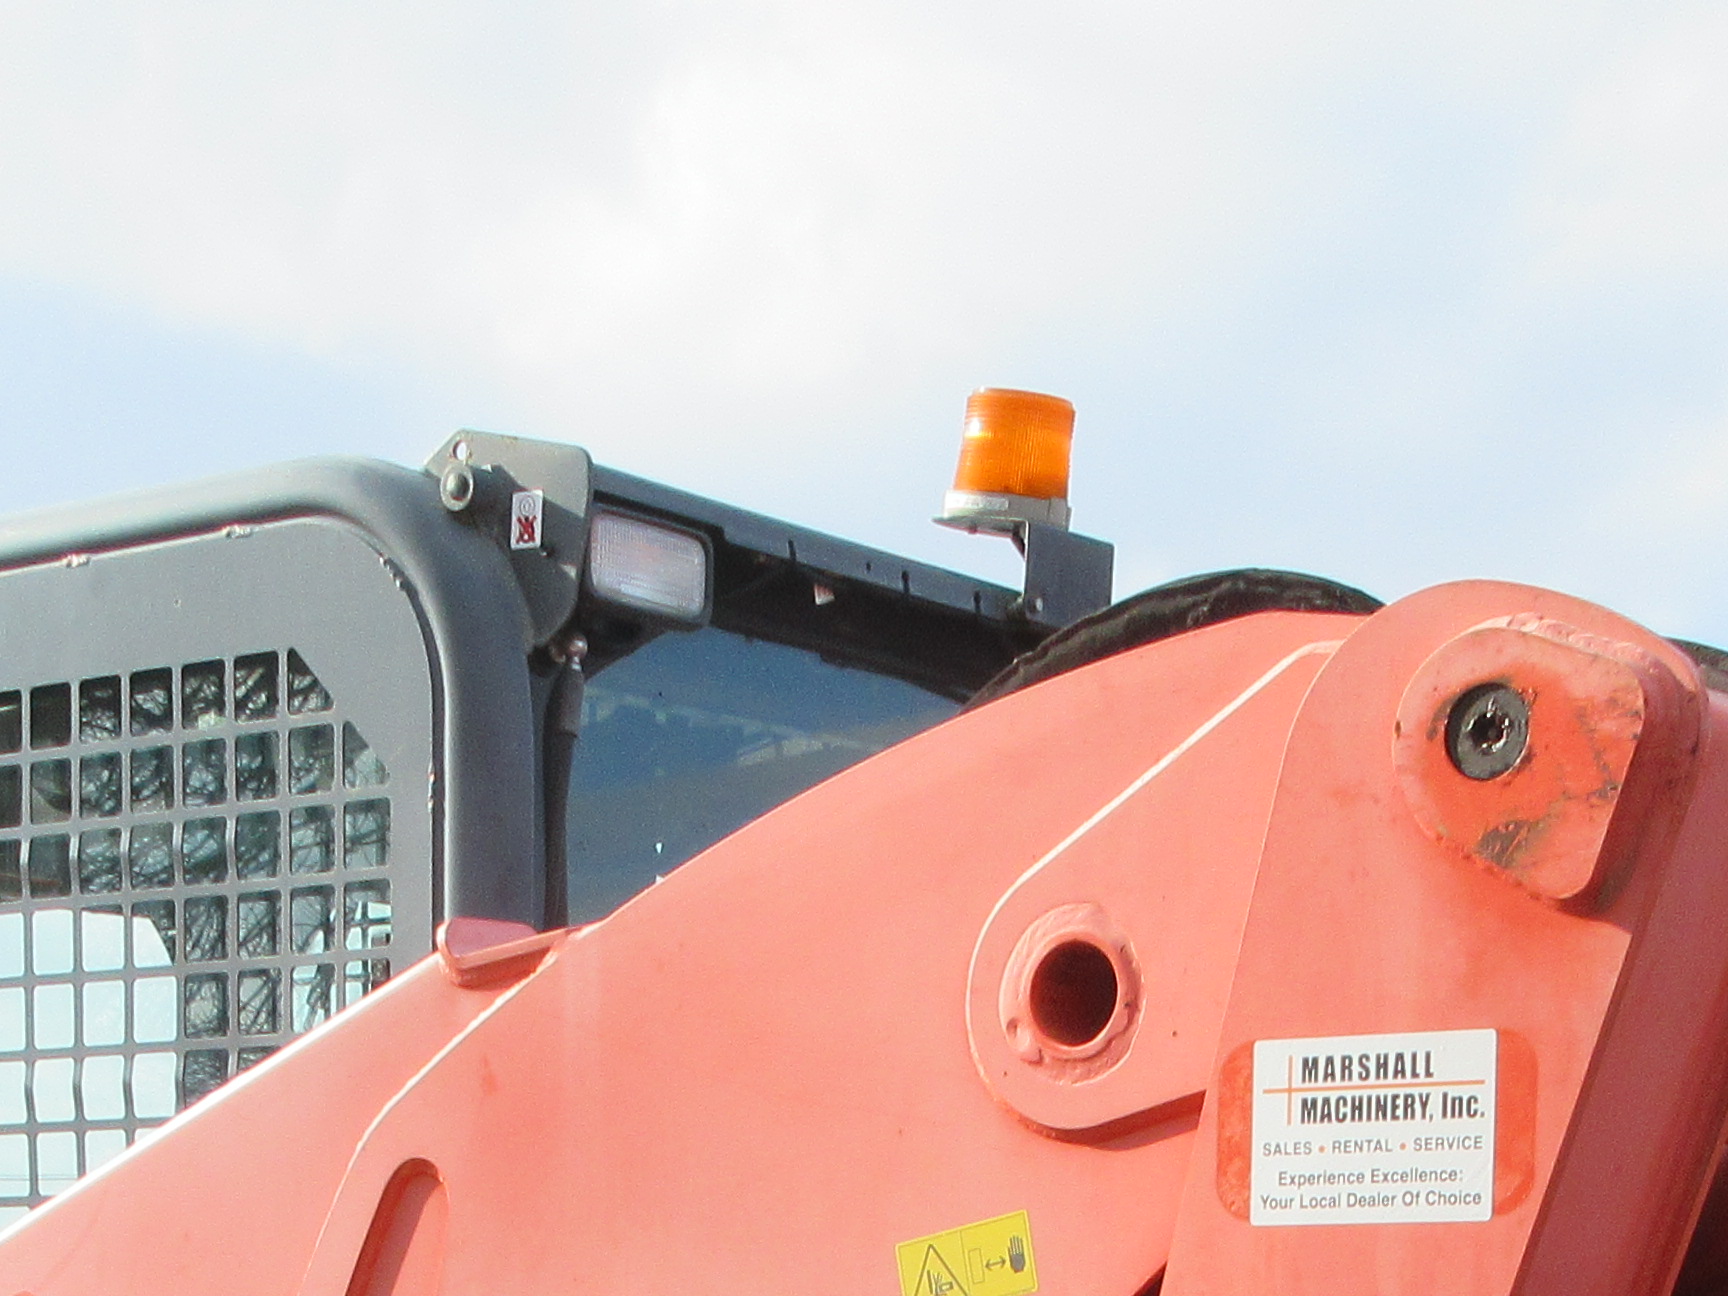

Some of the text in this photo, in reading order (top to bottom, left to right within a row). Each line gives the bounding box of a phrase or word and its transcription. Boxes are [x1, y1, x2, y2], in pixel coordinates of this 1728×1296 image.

[1301, 1050, 1435, 1084] MARSHALL
[1300, 1092, 1486, 1124] MACHINERY, Inc.
[1262, 1135, 1484, 1156] SALES RENTAL SERVICE
[1278, 1168, 1464, 1189] Experience Excellence:
[1260, 1189, 1482, 1210] Your Local Dealer Of Choice
